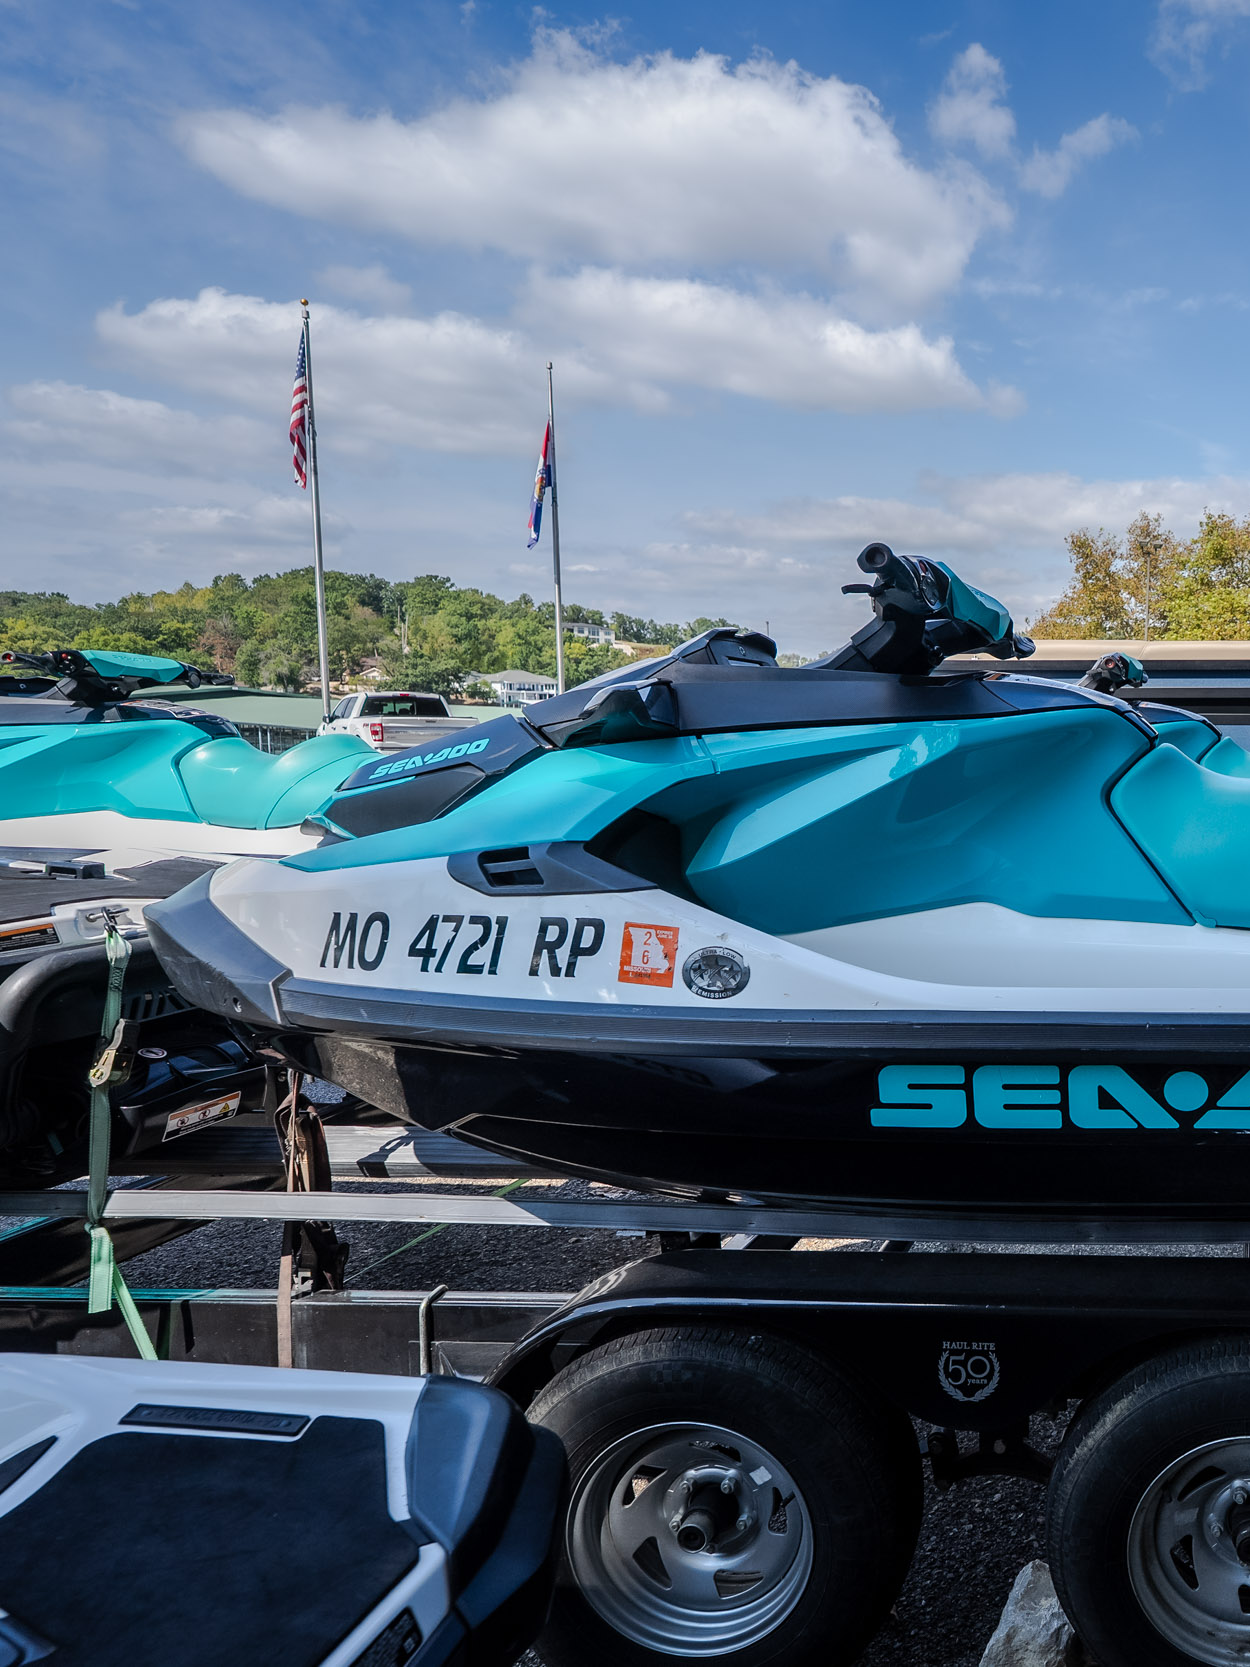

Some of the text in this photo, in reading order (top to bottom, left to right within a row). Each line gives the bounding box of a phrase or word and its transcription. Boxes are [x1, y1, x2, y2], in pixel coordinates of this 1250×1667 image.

[319, 911, 606, 978] MO 4721 RP
[643, 931, 653, 946] 2
[641, 950, 650, 965] 6
[722, 951, 737, 960] LOW
[698, 989, 734, 999] EMISSION
[942, 1341, 996, 1351] HAUL RITE
[948, 1352, 991, 1385] 50
[967, 1378, 988, 1386] years
